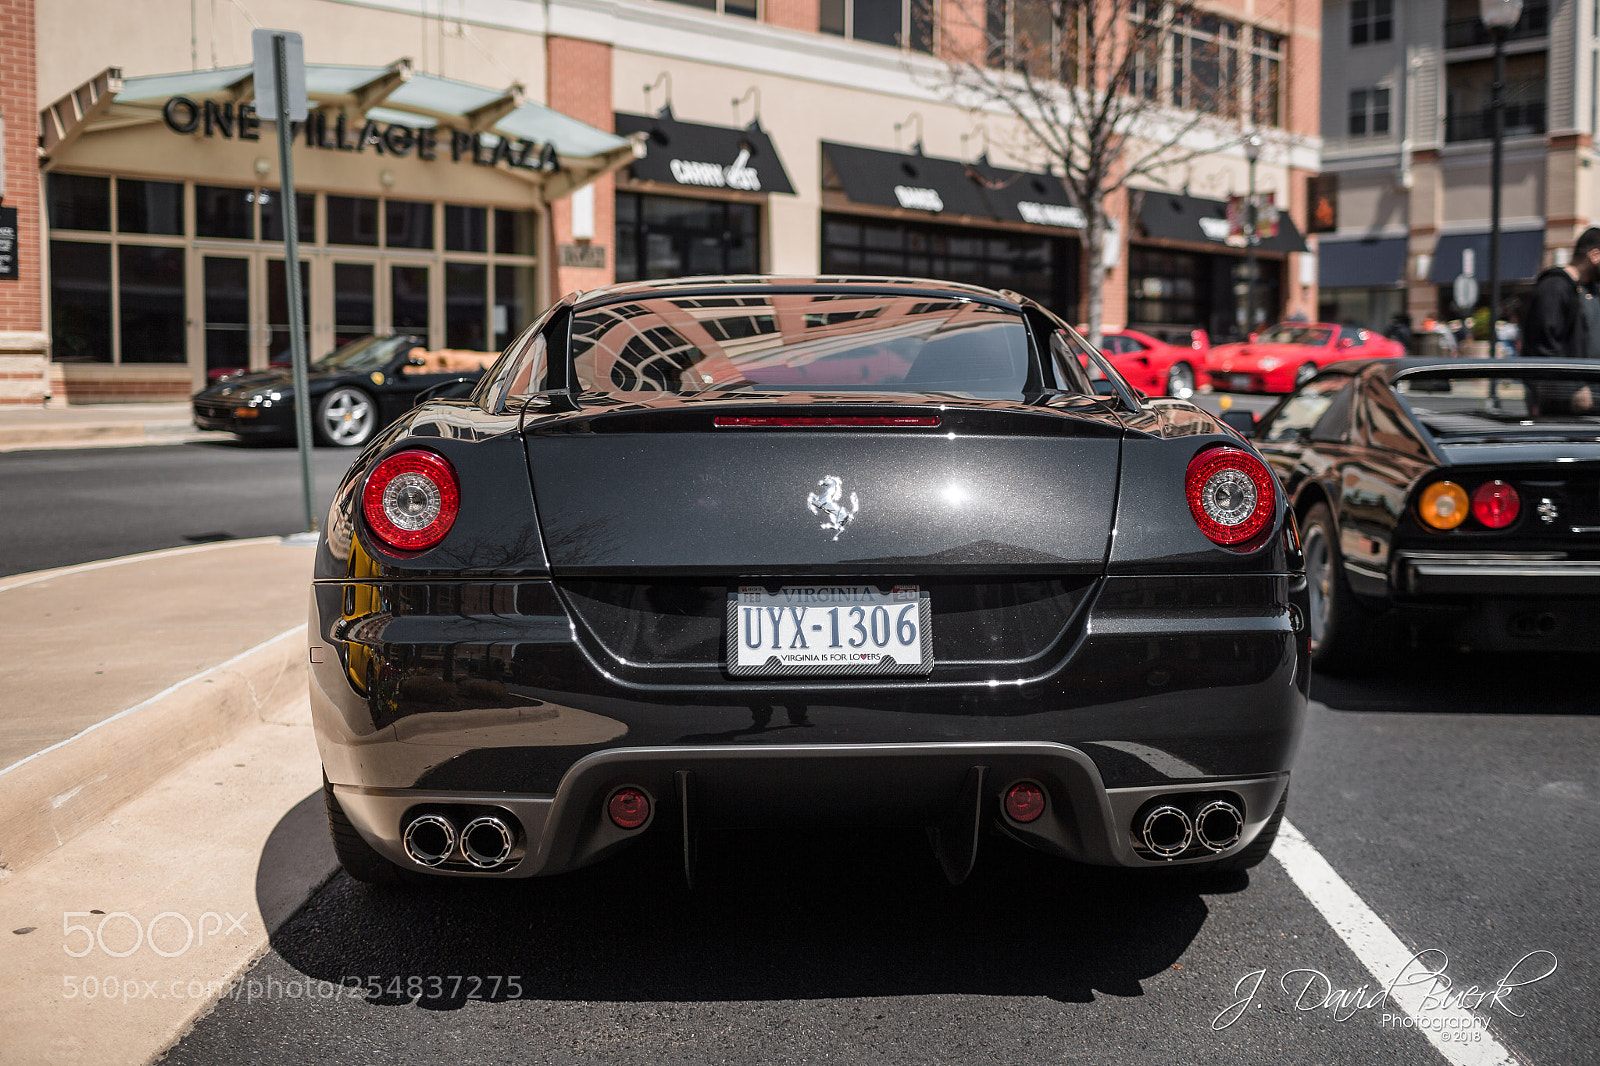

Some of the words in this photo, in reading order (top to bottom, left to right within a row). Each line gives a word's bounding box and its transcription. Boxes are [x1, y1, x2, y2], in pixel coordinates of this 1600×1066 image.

[163, 95, 260, 140] ONE
[450, 127, 560, 171] PLAZA
[743, 592, 761, 603] FEB
[782, 586, 875, 602] VIRGINIA
[743, 604, 917, 648] UYX-1306
[781, 654, 820, 662] VIRGINIA
